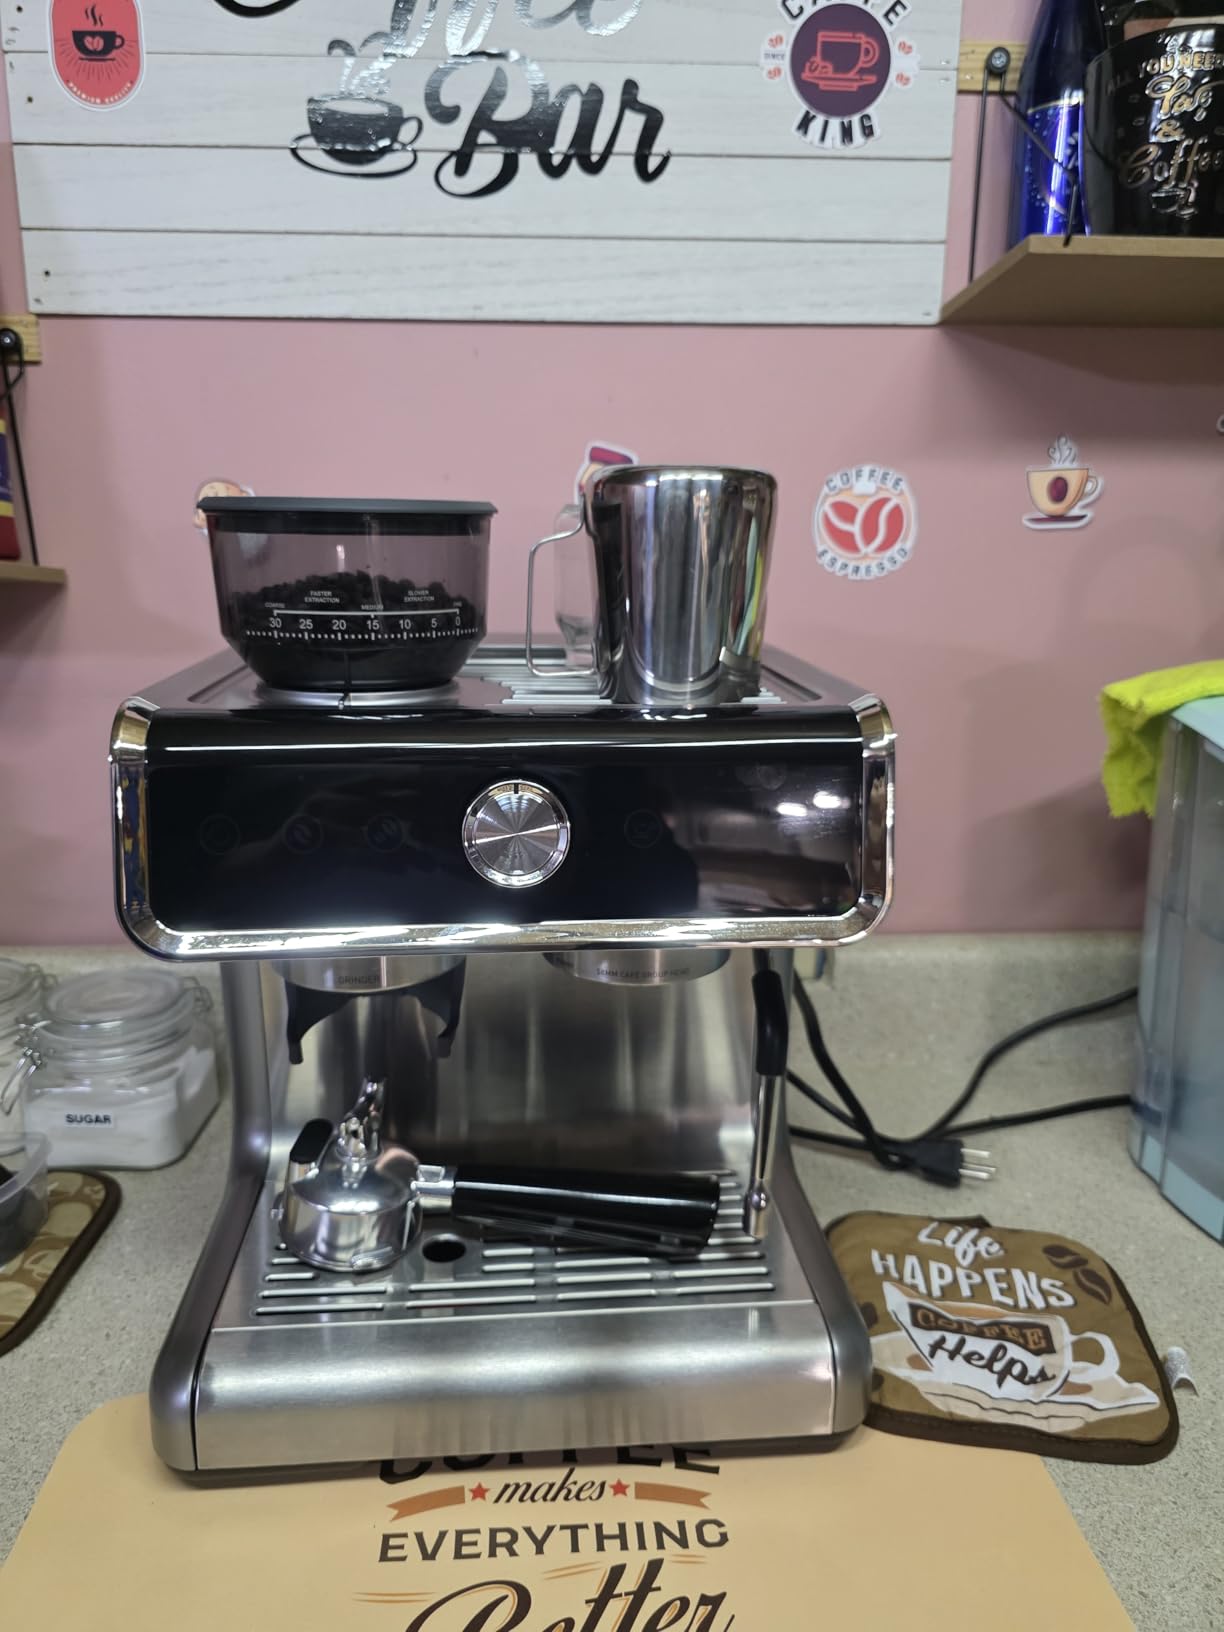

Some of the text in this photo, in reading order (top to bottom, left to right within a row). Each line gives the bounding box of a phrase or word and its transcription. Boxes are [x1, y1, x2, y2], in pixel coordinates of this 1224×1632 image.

[1138, 54, 1175, 78] YOU
[424, 51, 672, 197] Bar
[796, 110, 875, 145] KING
[1119, 137, 1224, 189] Coffee
[825, 469, 903, 491] COFFEE
[819, 548, 908, 577] ESPRESSO
[304, 596, 340, 604] EXTRACTION
[269, 616, 460, 630] 30 25 20 15 10 5 0
[337, 975, 381, 985] GRINDER
[66, 1113, 111, 1125] SUGAR
[918, 1221, 1004, 1267] Life
[870, 1249, 1077, 1310] HAPPENS
[916, 1305, 1047, 1351] COFFEE
[928, 1335, 1056, 1389] Helps
[493, 1467, 606, 1504] makes
[378, 1518, 730, 1563] EVERYTHING
